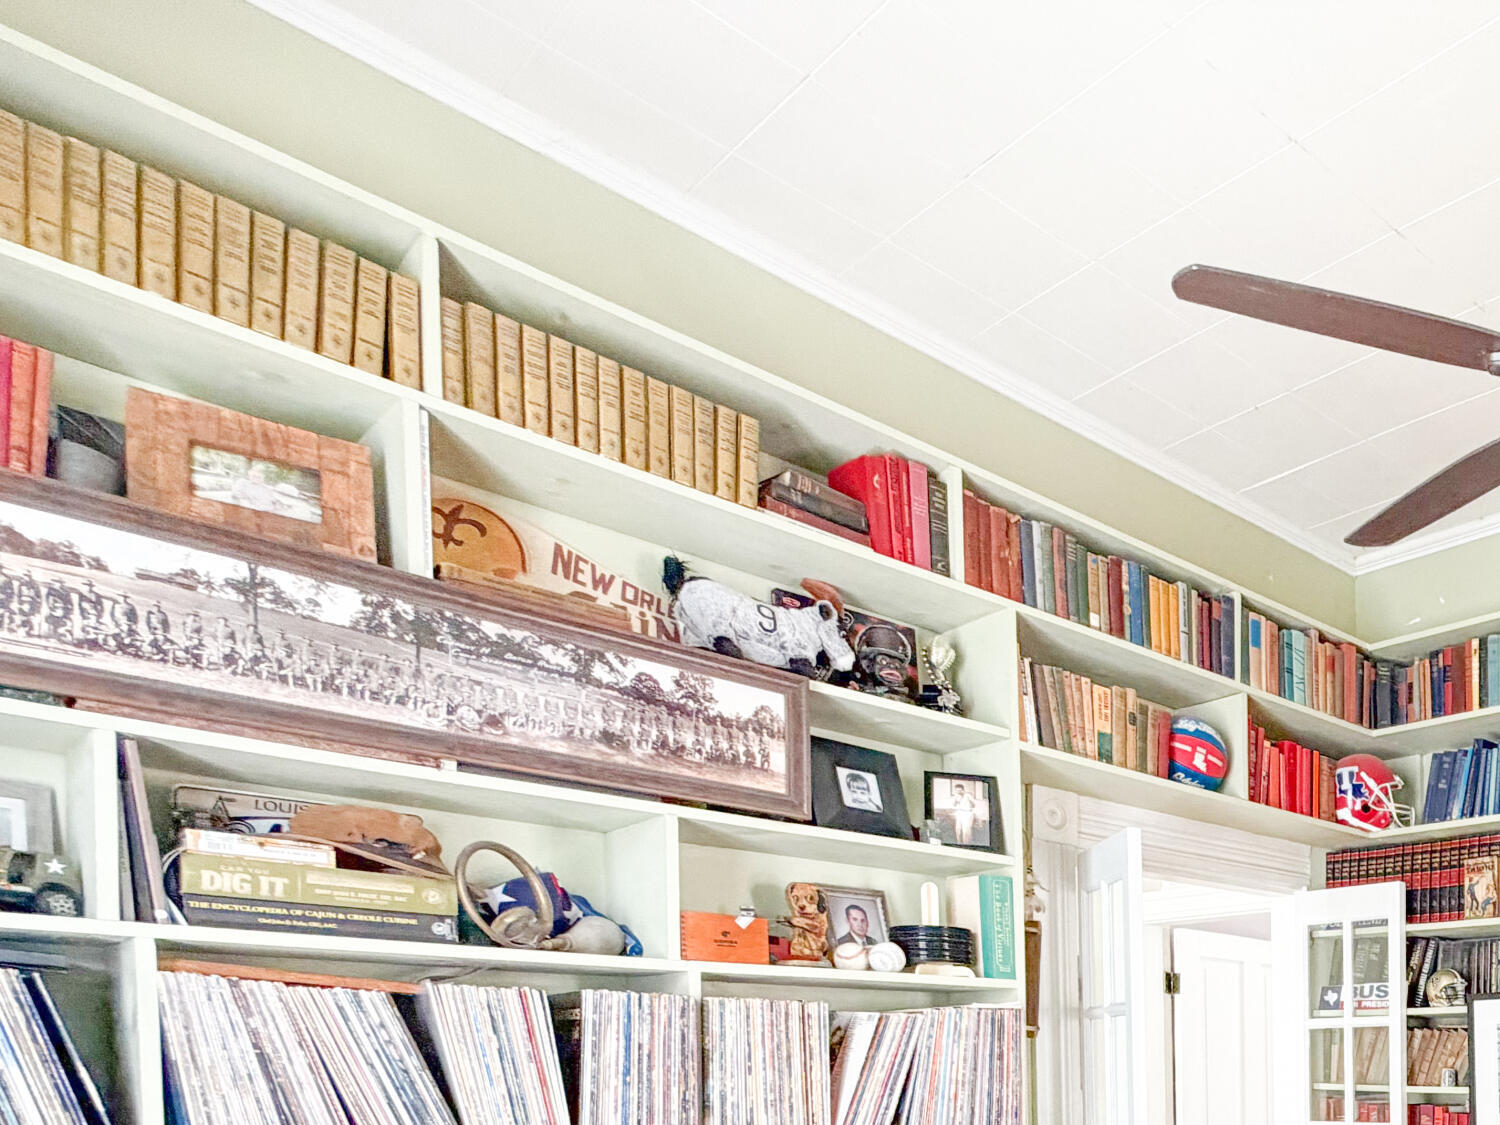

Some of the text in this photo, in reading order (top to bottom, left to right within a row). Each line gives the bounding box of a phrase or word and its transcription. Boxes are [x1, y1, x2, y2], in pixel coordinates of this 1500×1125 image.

[551, 541, 615, 596] NEW
[757, 603, 778, 633] 9
[200, 868, 251, 894] DIG
[256, 874, 289, 899] IT
[187, 900, 210, 911] THE
[211, 902, 289, 917] ENCYCLOPEDIA
[289, 908, 304, 917] OF
[304, 910, 337, 921] CAJUN
[346, 912, 382, 923] CREOLE
[383, 915, 419, 926] CUISINE
[994, 903, 1004, 924] Book
[995, 934, 1006, 964] Virtues
